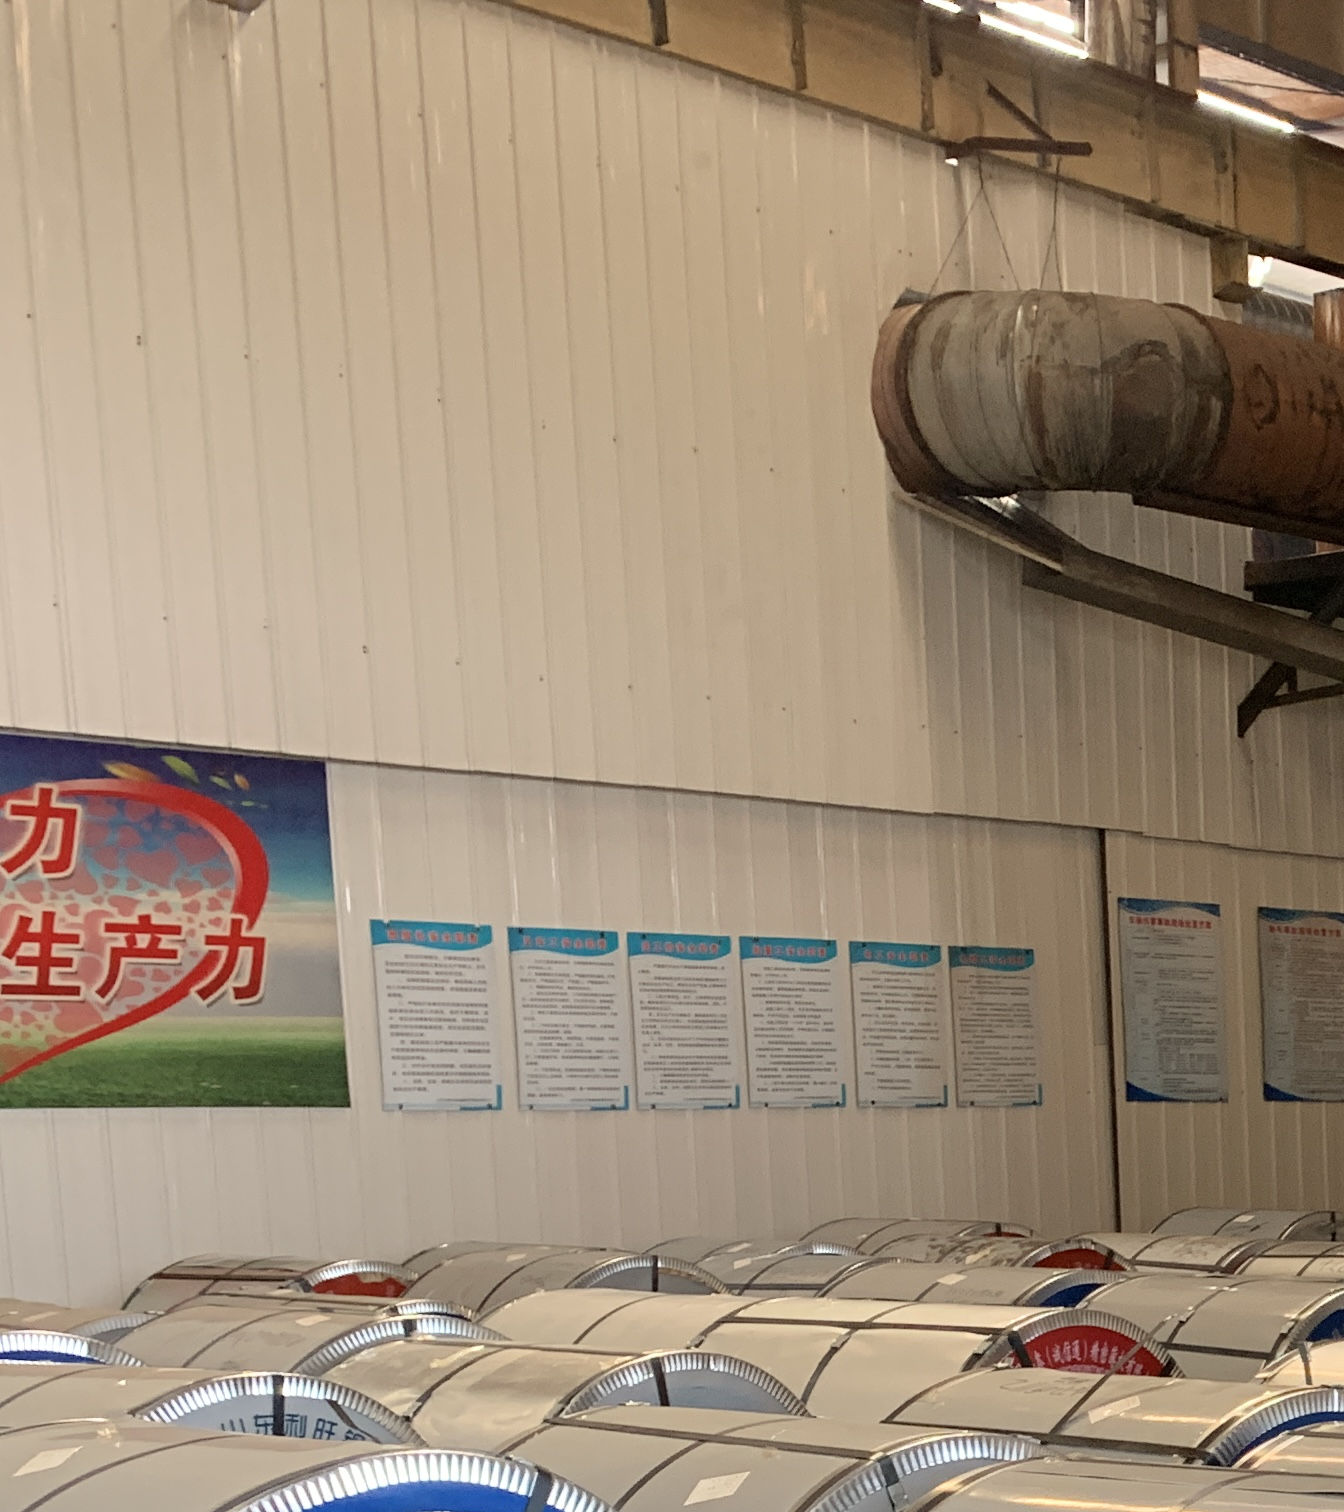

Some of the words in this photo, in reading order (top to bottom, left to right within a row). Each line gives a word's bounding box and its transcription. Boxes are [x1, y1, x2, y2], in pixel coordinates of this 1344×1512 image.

[2, 787, 79, 876] 力
[2, 912, 267, 1001] 生产力
